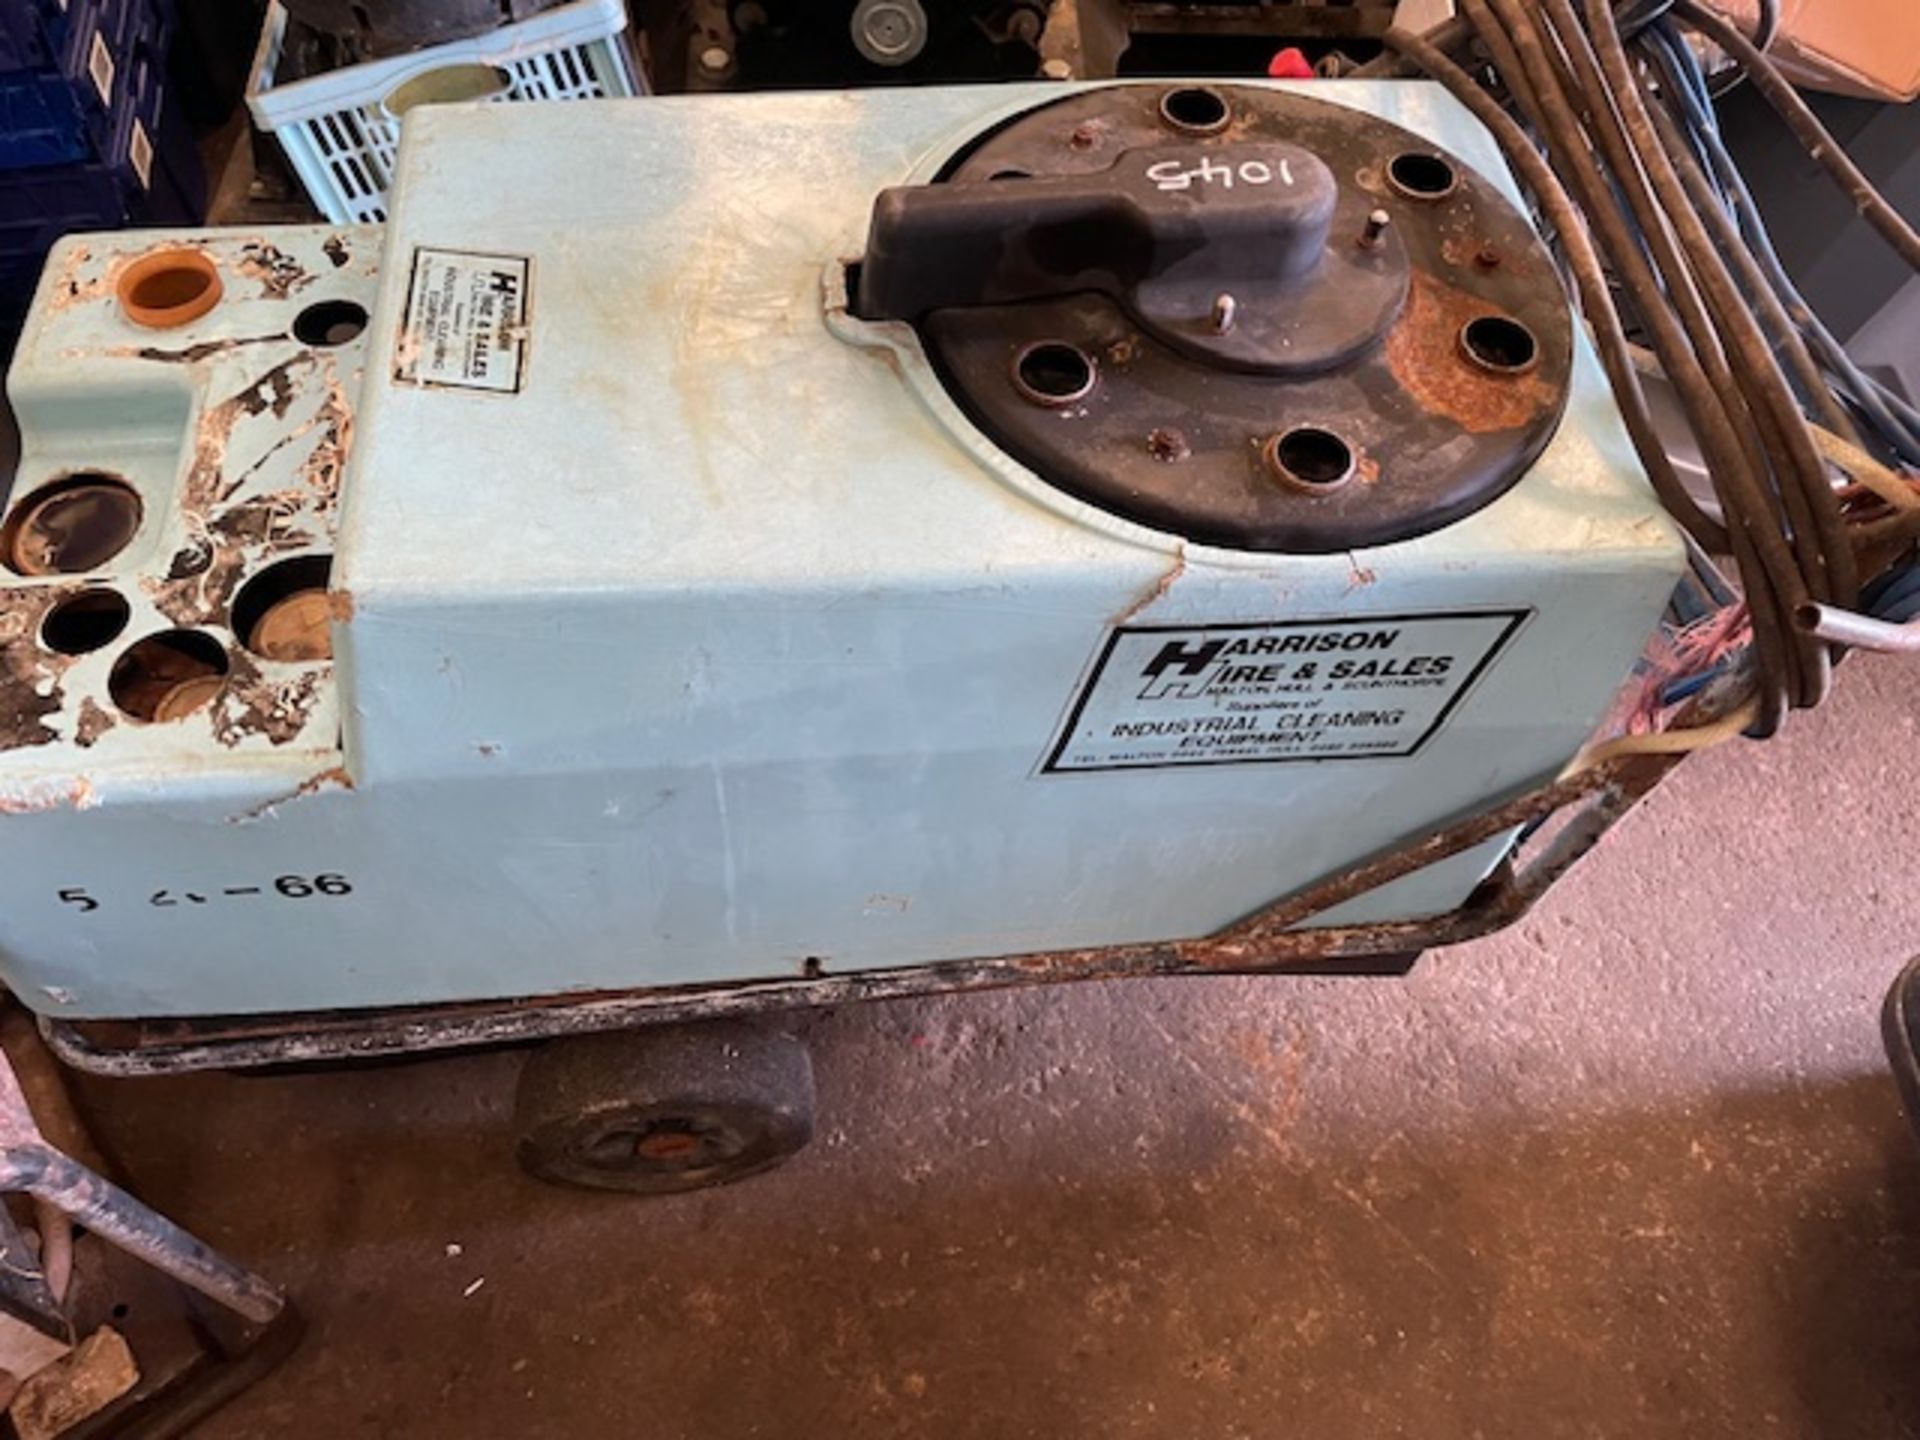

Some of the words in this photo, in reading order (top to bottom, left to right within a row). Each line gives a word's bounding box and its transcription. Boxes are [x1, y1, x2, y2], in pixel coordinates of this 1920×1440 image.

[1145, 156, 1295, 191] 1045
[1139, 629, 1400, 677] HARRISON
[1291, 661, 1318, 679] &
[1328, 655, 1453, 679] SALES
[1112, 715, 1261, 738] INDUSTRIAL
[1276, 709, 1406, 730] CLEANING
[1178, 730, 1324, 749] EQUIPMENT
